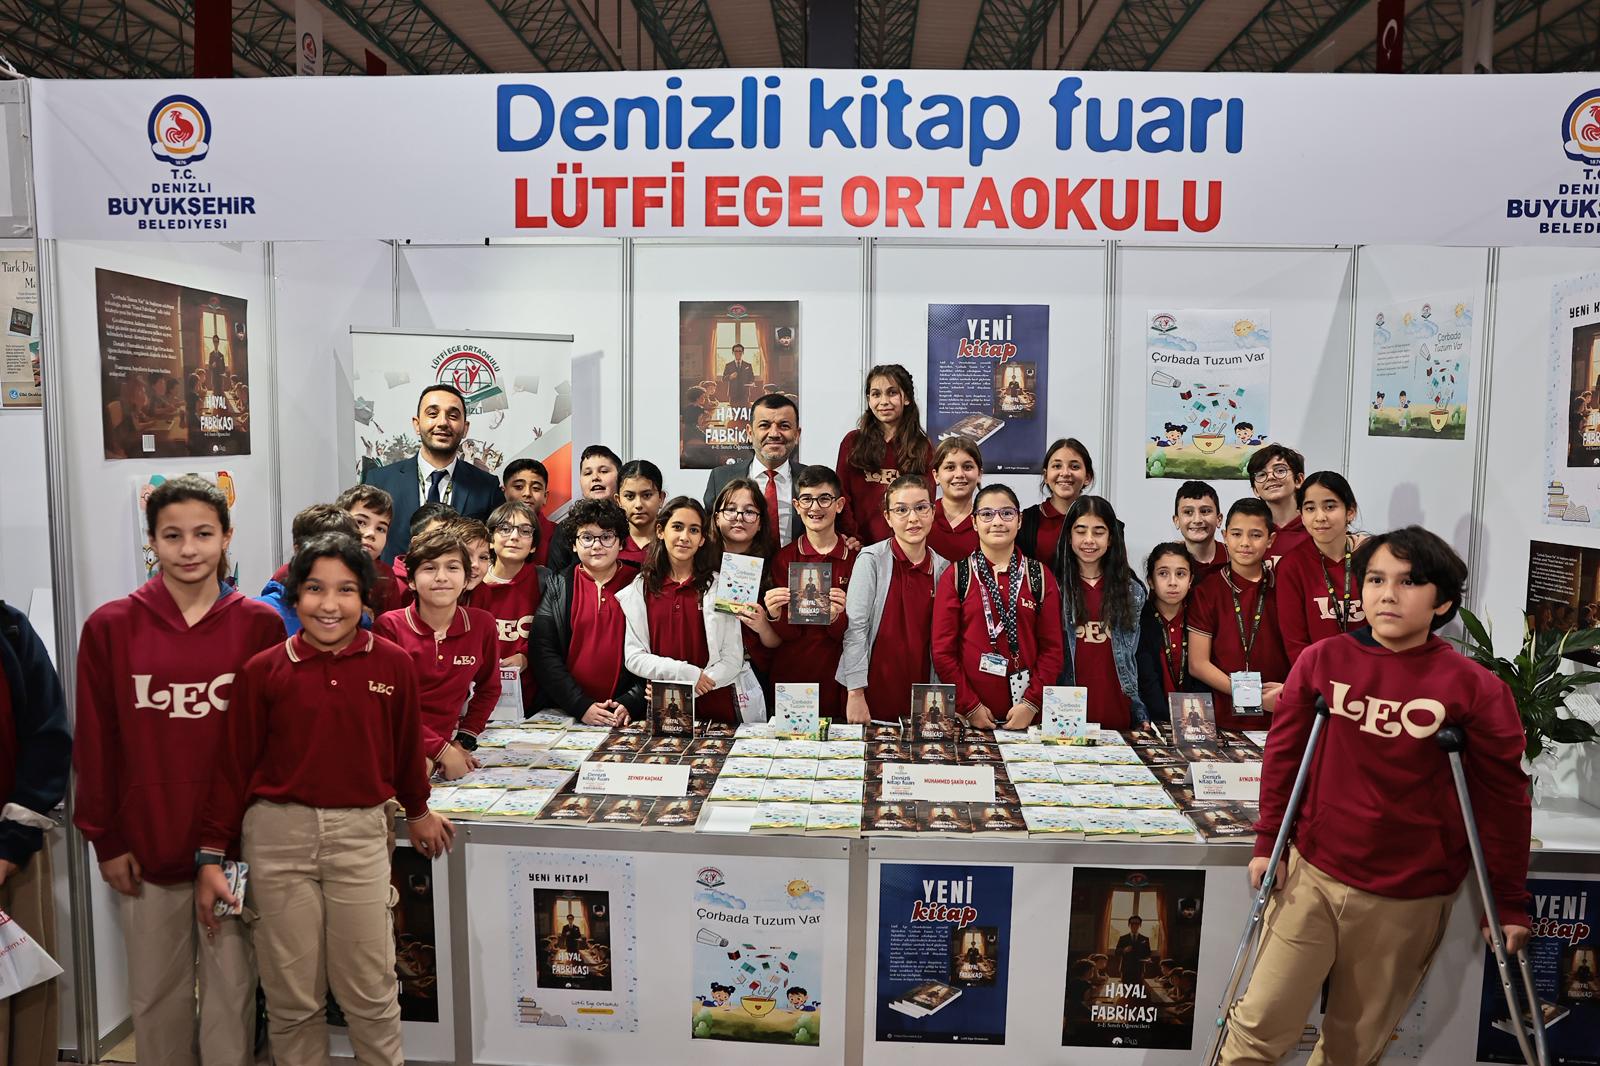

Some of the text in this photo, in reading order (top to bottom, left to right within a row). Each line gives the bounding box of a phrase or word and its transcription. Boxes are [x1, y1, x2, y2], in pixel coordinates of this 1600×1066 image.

[496, 75, 1244, 167] Denizli kitap fuarı
[171, 169, 196, 180] T.C.
[514, 161, 1222, 233] LÜTFİ EGE ORTAOKULU
[1506, 199, 1600, 218] BÜYÜK
[1570, 304, 1590, 318] YENİ
[967, 314, 1013, 341] YENİ
[957, 338, 1017, 365] kitap
[1151, 351, 1265, 366] Çorbada Tuzum Var
[705, 427, 752, 444] FABRİKA
[1329, 680, 1446, 739] LEO
[529, 873, 588, 884] YENİ KİTAP!
[922, 876, 973, 904] YENİ
[911, 900, 978, 929] kitap
[1534, 892, 1588, 920] YENİ
[696, 908, 821, 926] Çorbada Tuzum Var
[1105, 983, 1148, 999] HAYAL
[1090, 1004, 1158, 1023] FABRİKASI
